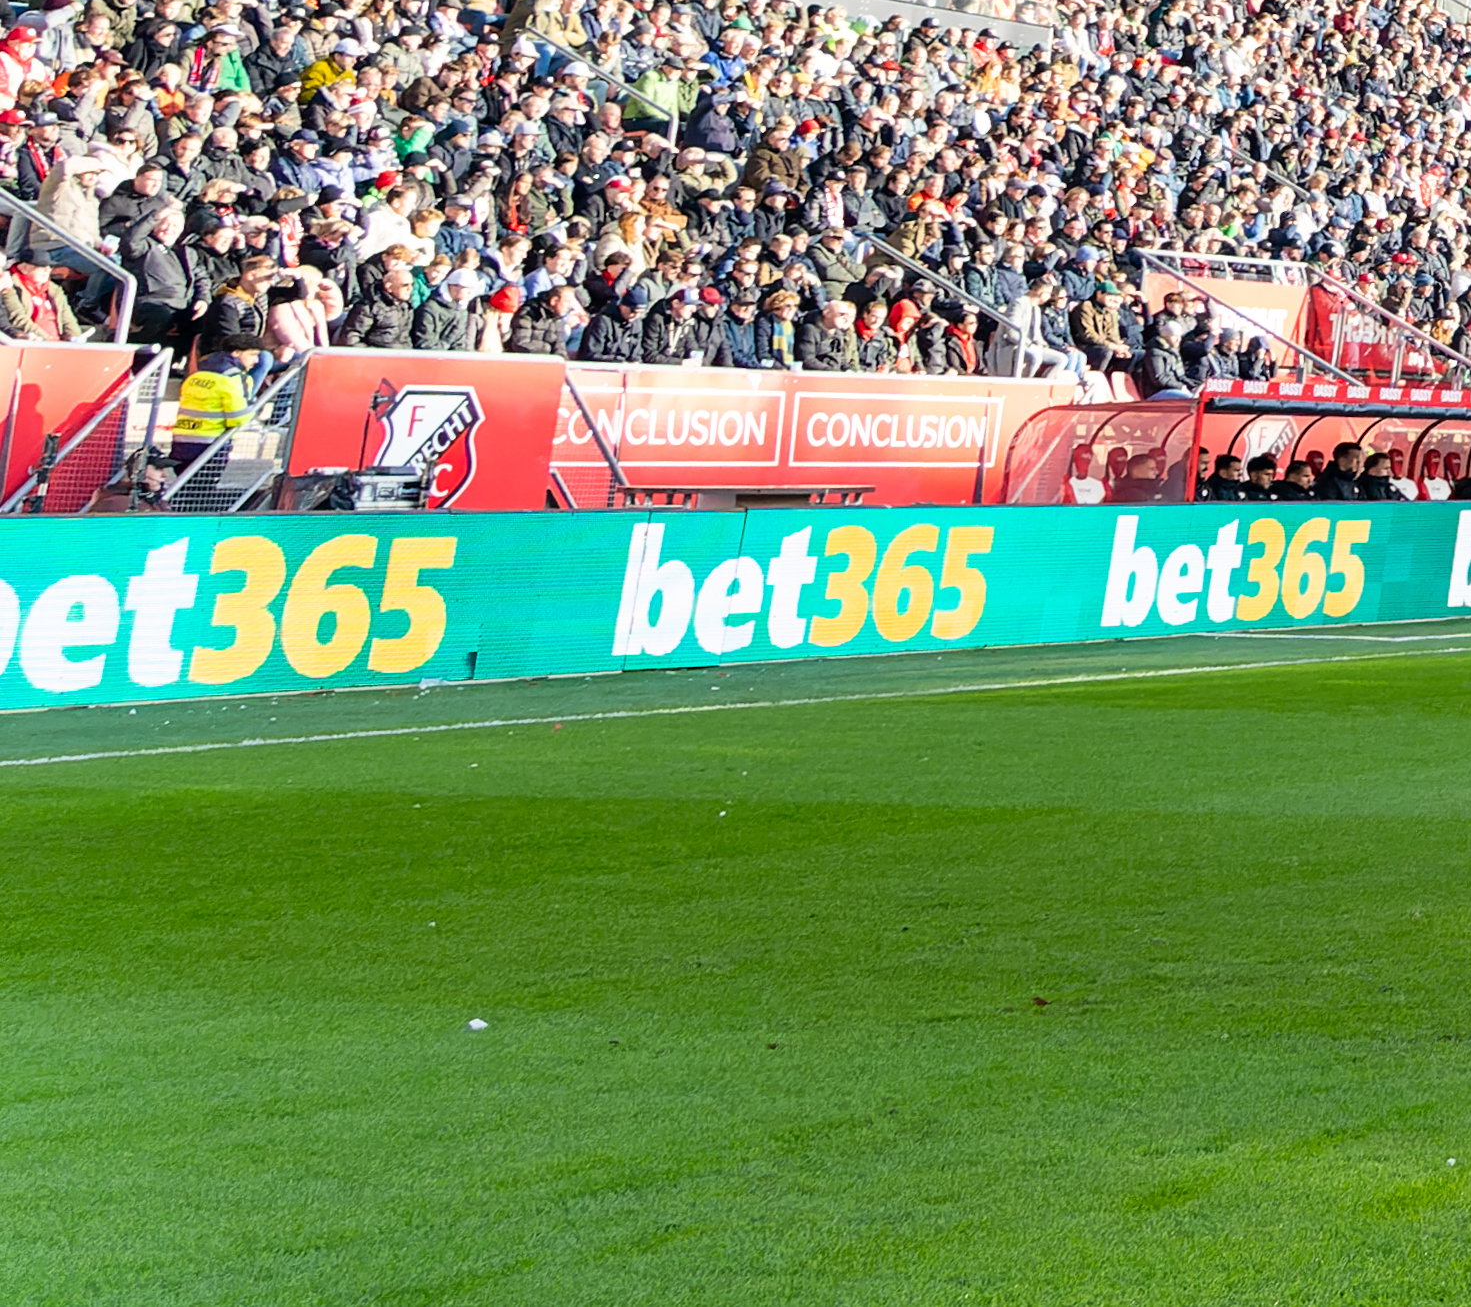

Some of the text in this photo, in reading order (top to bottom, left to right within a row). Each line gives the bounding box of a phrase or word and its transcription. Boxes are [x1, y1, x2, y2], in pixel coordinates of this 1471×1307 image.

[1206, 378, 1234, 393] DASSY
[1243, 380, 1269, 394] DASSY
[1279, 382, 1304, 396] DASSY
[1313, 384, 1338, 398] DASSY
[1347, 386, 1372, 399] DASSY
[1380, 387, 1403, 401] DASSY
[1410, 388, 1433, 402] DASSY
[407, 404, 426, 438] F
[409, 398, 475, 477] RECHT
[552, 407, 768, 448] CONCLUSION
[806, 411, 987, 449] CONCLUSION
[430, 463, 454, 498] C
[612, 522, 995, 656] bet365
[1101, 514, 1371, 628] bet365
[0, 534, 458, 693] et365
